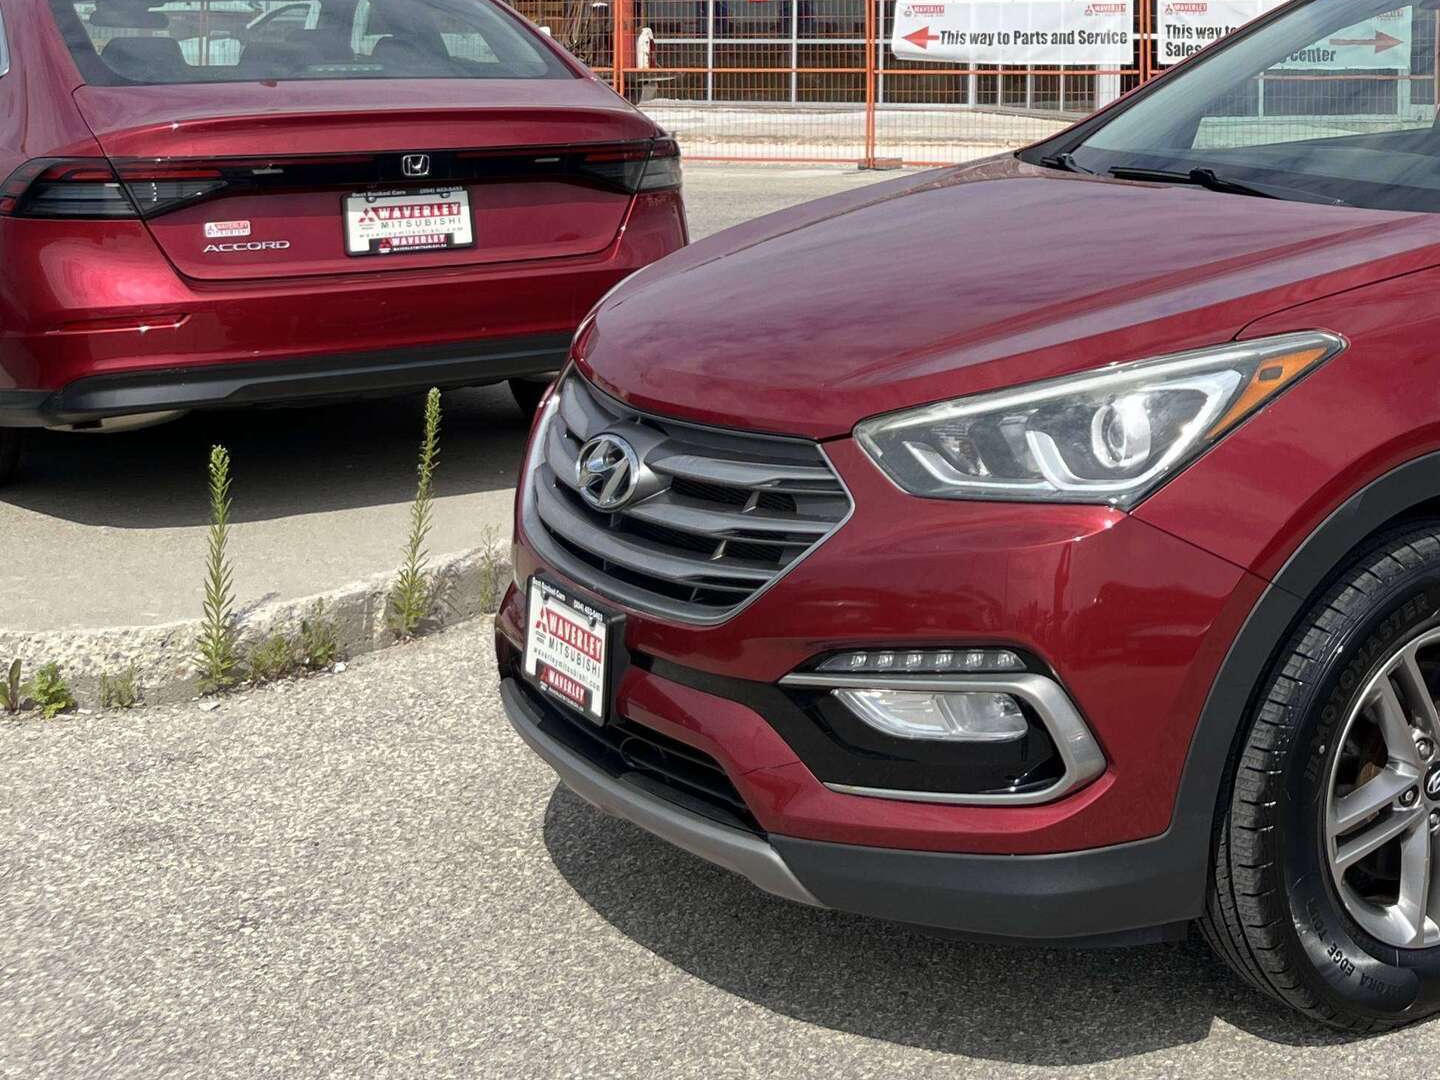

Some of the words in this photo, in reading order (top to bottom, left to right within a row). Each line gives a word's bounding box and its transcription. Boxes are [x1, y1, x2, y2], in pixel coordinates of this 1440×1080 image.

[940, 30, 966, 45] This
[970, 33, 994, 47] way
[997, 31, 1010, 45] to
[1013, 30, 1048, 45] Parts
[1051, 30, 1075, 45] and
[1078, 29, 1128, 45] Service
[1165, 24, 1193, 39] This
[379, 204, 459, 219] WAVERLEY
[380, 217, 462, 229] MITSUBISHI
[203, 240, 290, 253] ACCORD
[391, 235, 446, 246] WAVERLEY
[549, 610, 602, 659] WAVERLEY
[548, 636, 601, 678] MITSUBISHI
[548, 669, 585, 702] WAVERLEY
[1327, 942, 1356, 977] EDGE
